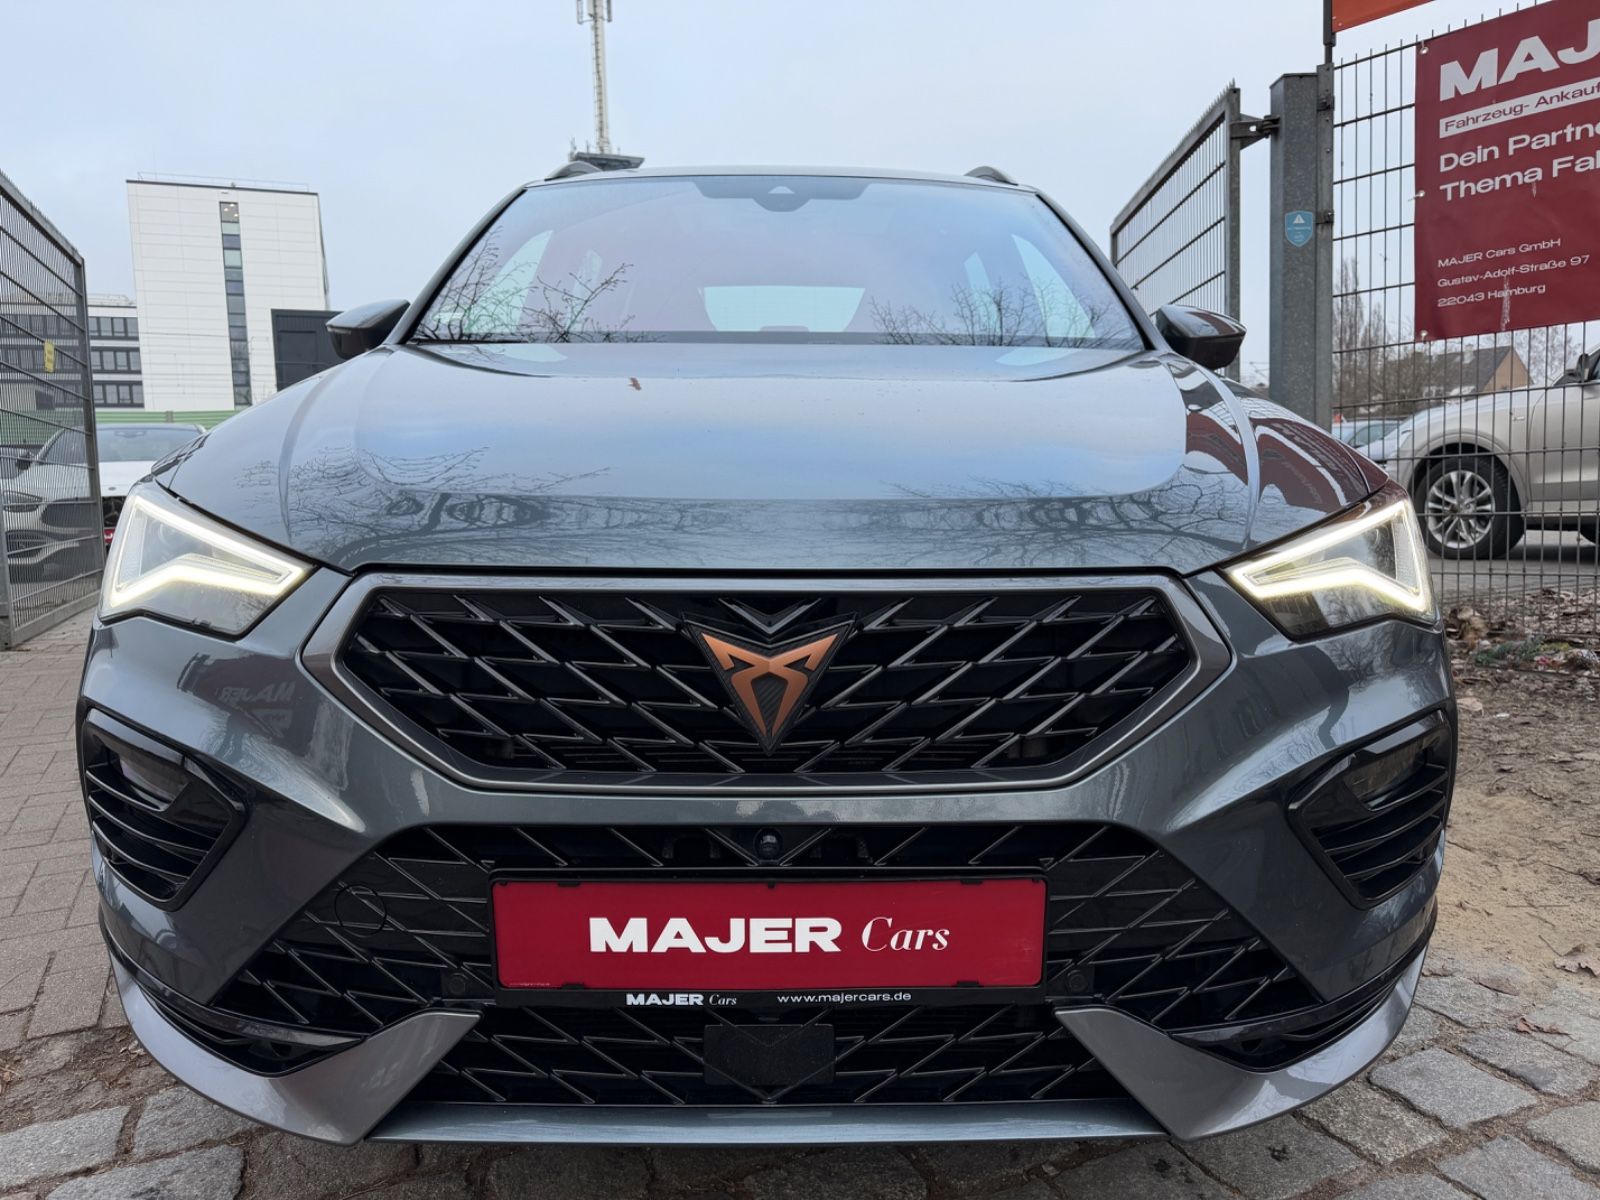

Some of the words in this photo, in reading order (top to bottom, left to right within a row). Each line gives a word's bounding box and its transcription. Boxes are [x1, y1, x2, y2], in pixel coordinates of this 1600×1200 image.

[1440, 18, 1600, 101] MAJ
[1444, 104, 1530, 132] Fahrzeug-
[1440, 143, 1500, 173] Dein
[1440, 166, 1543, 201] Thema
[1438, 252, 1483, 268] MAJER
[1485, 247, 1516, 259] Cars
[1518, 238, 1561, 253] GmbH
[1437, 259, 1567, 287] Gustav-Adolf-Straße
[1570, 254, 1590, 266] 97
[1437, 292, 1485, 308] 22043
[1488, 284, 1546, 299] Hamburg
[589, 917, 842, 953] MAJER
[861, 916, 951, 952] Cars
[626, 993, 704, 1006] MAJER
[708, 993, 737, 1006] Cars
[777, 992, 912, 1004] www.majercars.de
